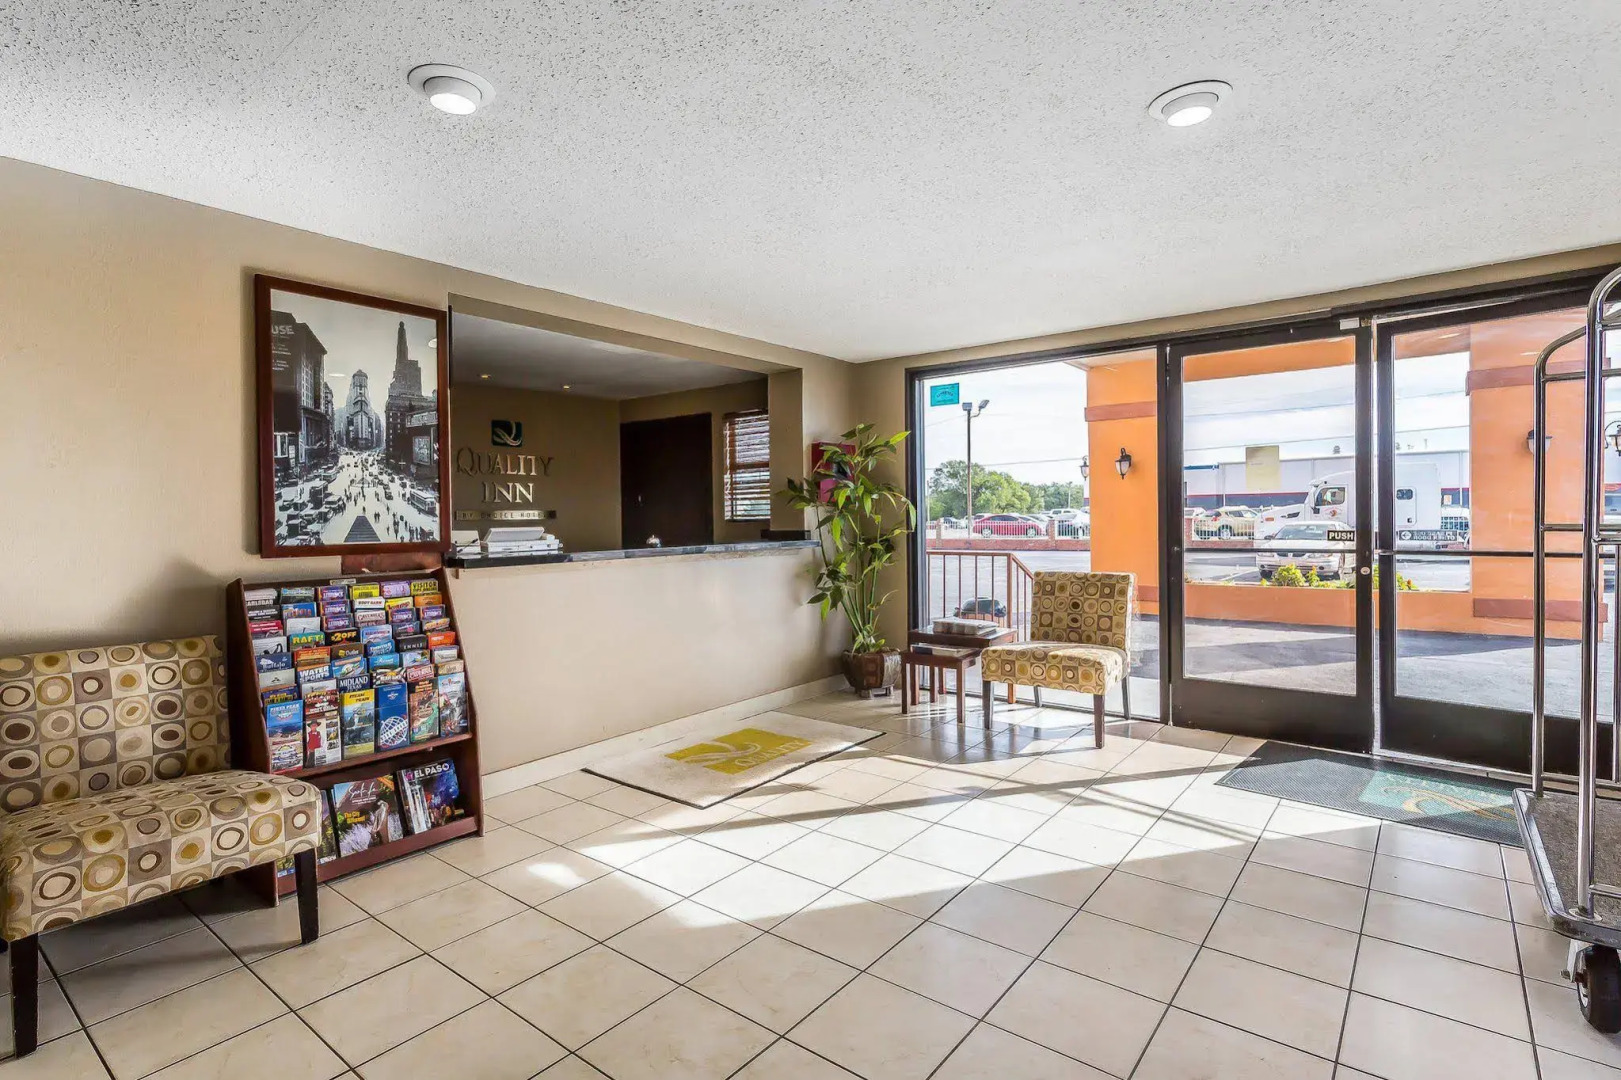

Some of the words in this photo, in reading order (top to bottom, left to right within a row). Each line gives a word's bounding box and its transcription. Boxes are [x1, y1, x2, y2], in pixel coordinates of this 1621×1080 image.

[457, 447, 554, 477] QUALITY
[482, 482, 534, 503] INN
[1329, 532, 1353, 540] PUSH
[292, 634, 324, 644] RAFT!
[299, 666, 329, 677] WATER
[300, 672, 329, 682] SPORTS
[340, 675, 369, 687] MIDLAND
[735, 740, 807, 767] QUALITY
[414, 769, 424, 778] EL
[425, 763, 450, 775] PASO
